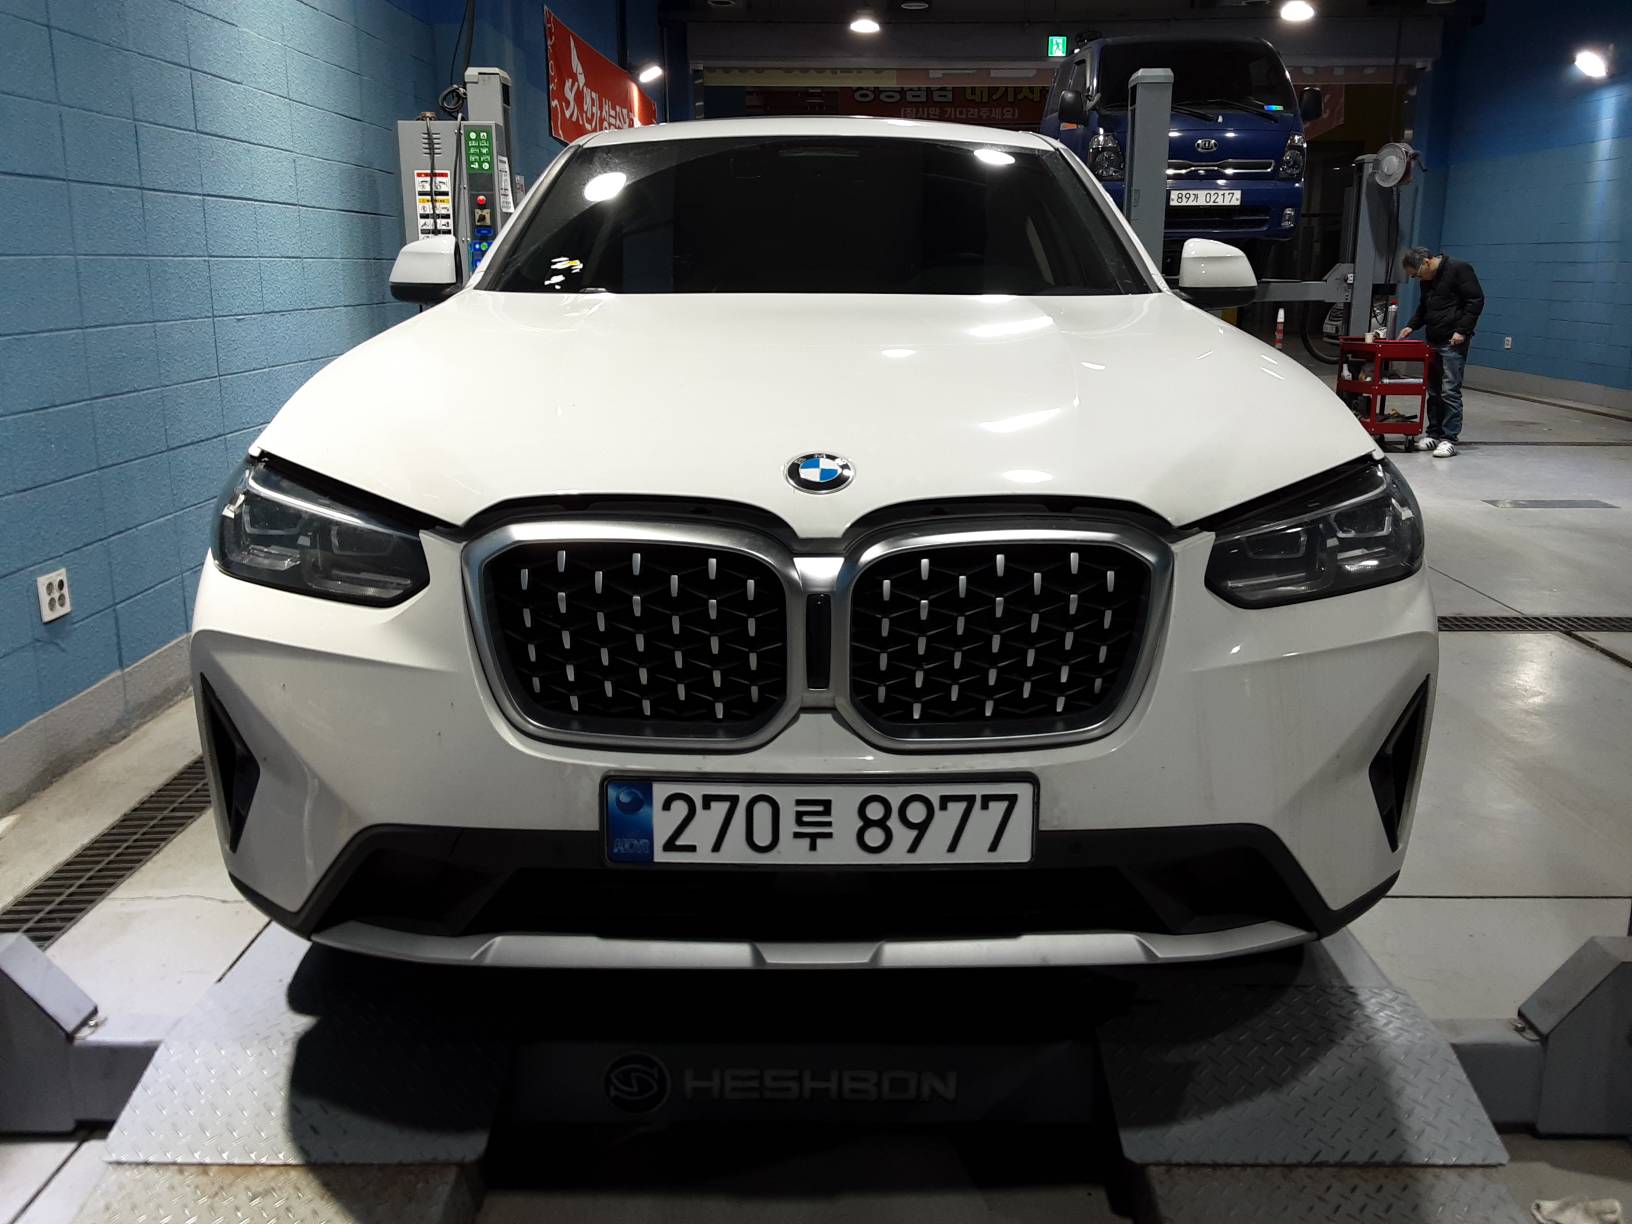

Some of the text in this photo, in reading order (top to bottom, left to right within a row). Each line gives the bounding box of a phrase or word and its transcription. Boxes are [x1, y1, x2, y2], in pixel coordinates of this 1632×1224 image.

[1205, 192, 1235, 204] 0217
[661, 792, 1019, 854] 270루 8977
[685, 1068, 958, 1102] HESHBON
